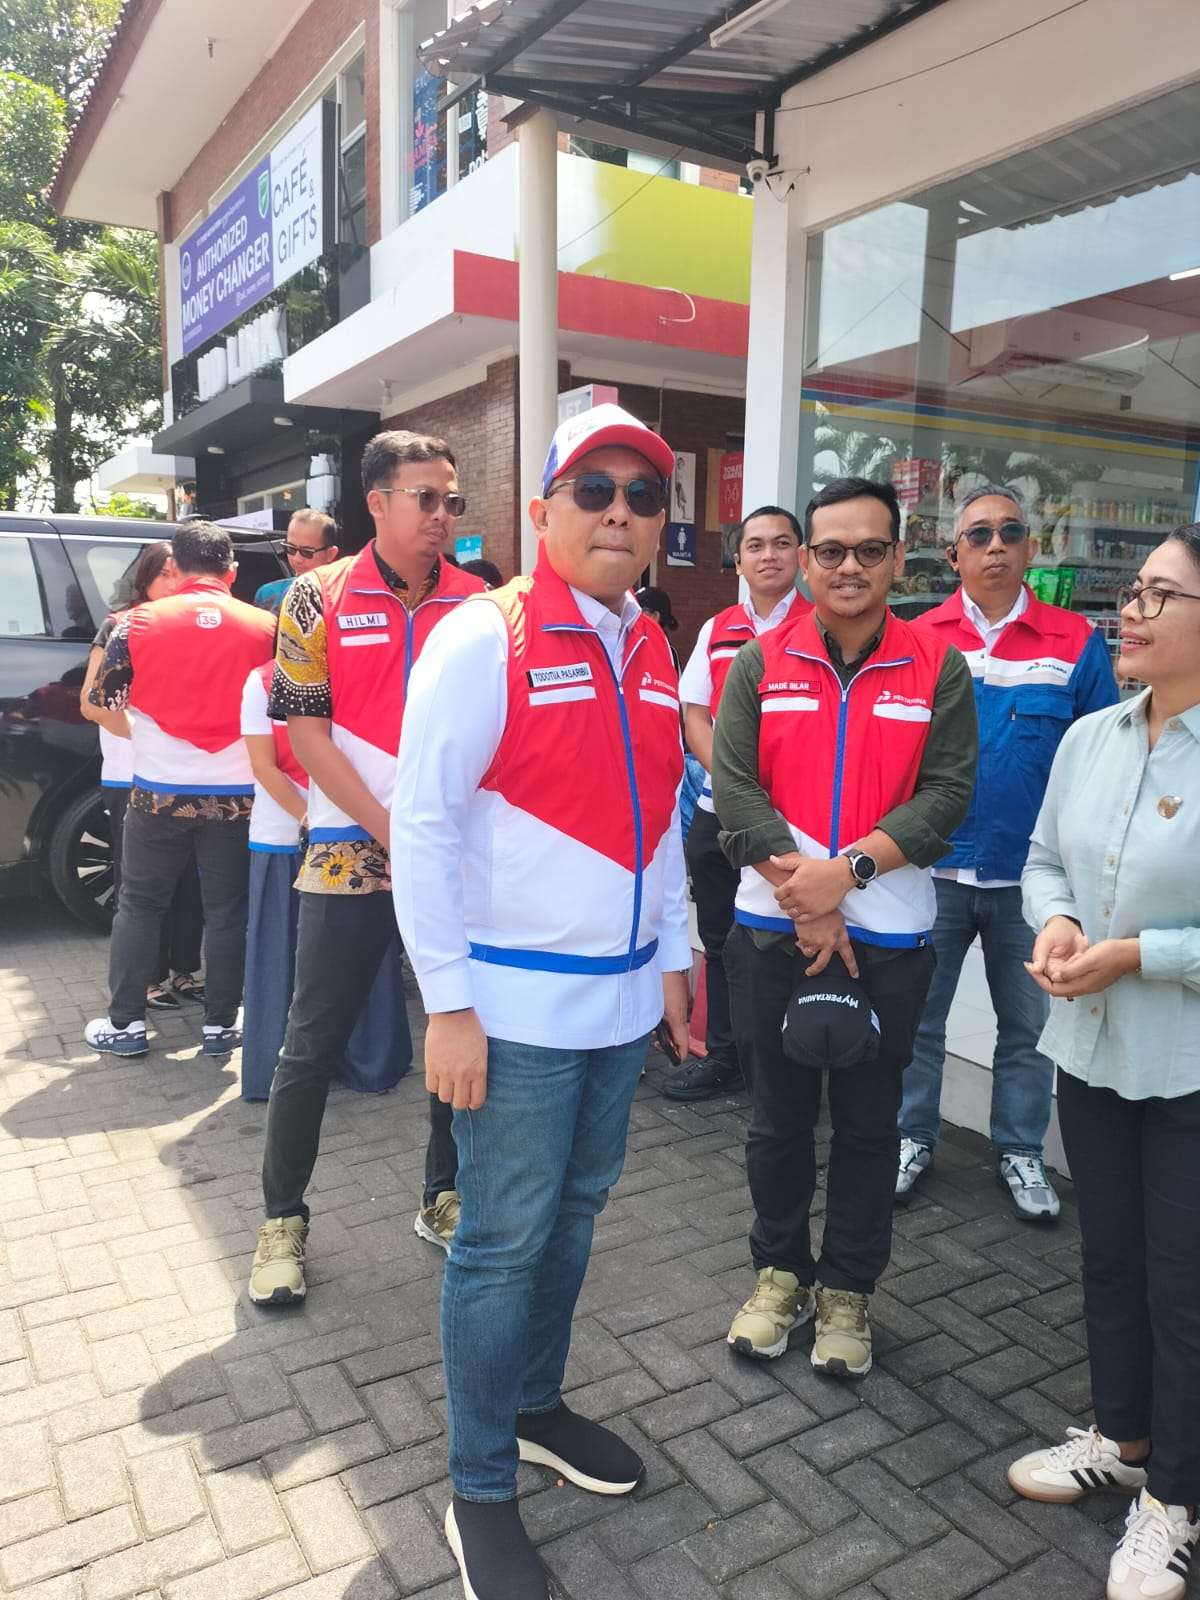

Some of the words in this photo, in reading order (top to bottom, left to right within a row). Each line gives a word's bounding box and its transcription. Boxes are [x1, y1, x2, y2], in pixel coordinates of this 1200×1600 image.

[197, 215, 248, 282] AUTHORIZED
[278, 203, 317, 264] GIFTS
[182, 281, 215, 330] MONEY
[216, 231, 270, 302] CHANGER
[198, 615, 218, 625] 135
[346, 614, 381, 627] HILMI
